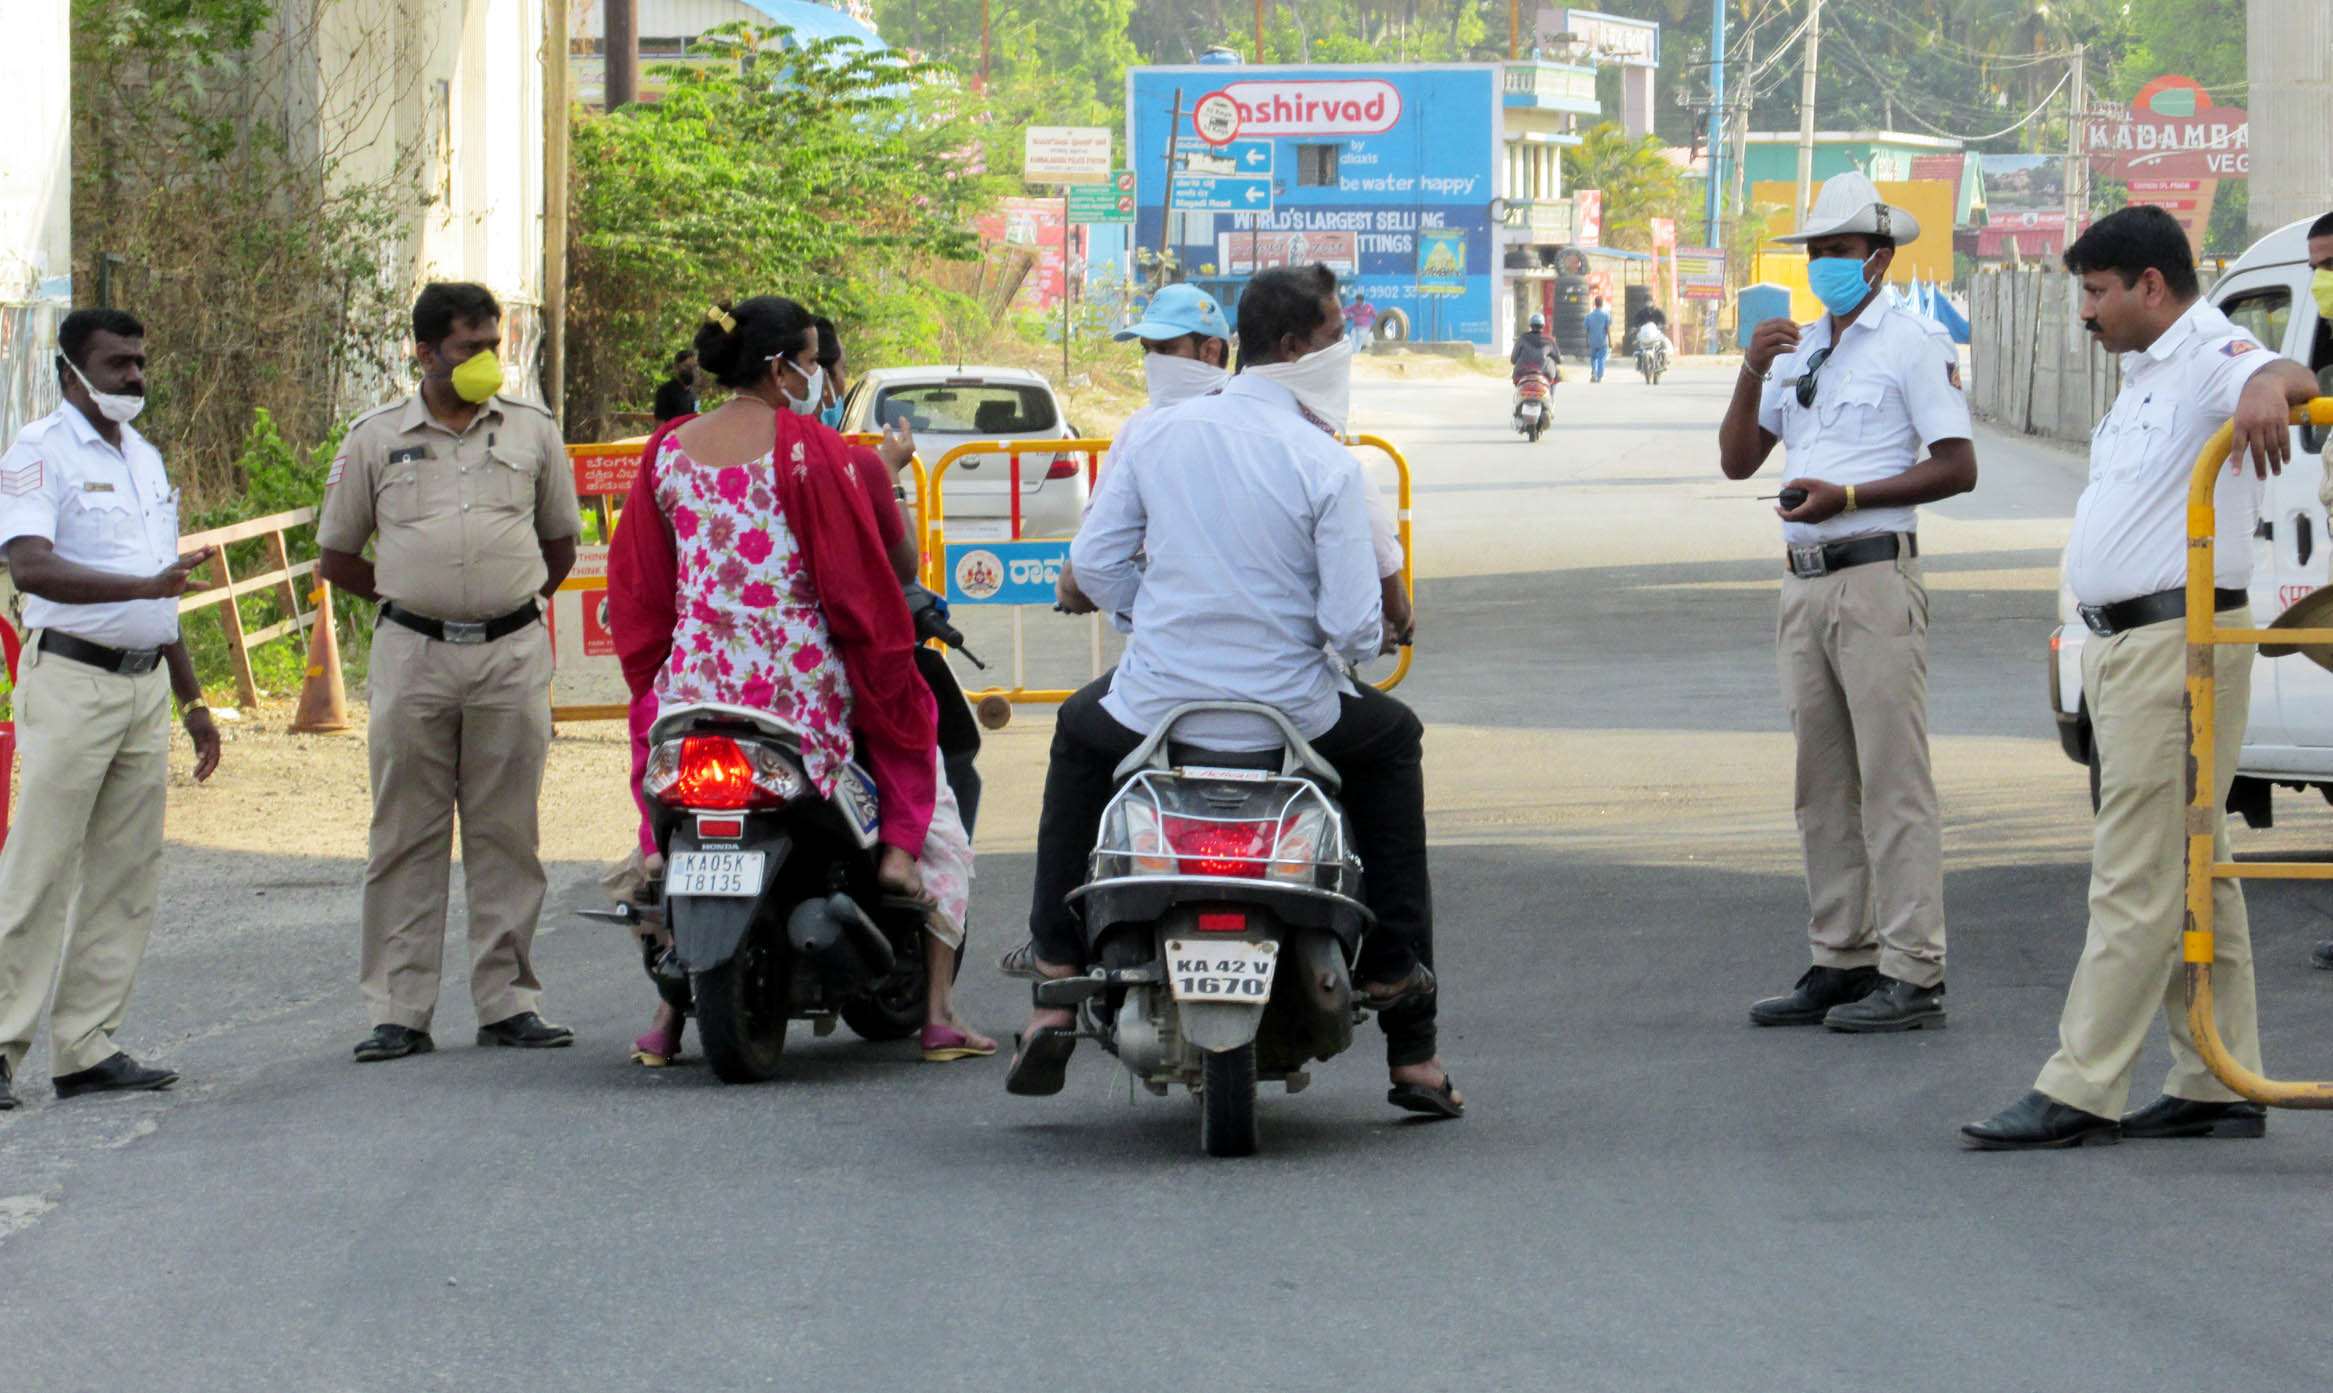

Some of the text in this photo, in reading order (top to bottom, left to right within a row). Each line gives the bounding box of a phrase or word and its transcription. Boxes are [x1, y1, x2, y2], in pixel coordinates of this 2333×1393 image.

[1351, 140, 1365, 152] by
[1340, 173, 1475, 195] be water happy
[1305, 211, 1373, 230] LARGEST
[702, 843, 740, 851] HONDA
[686, 855, 745, 872] KA05K
[685, 874, 742, 892] T8135
[1177, 960, 1269, 974] KA 42 V
[1178, 978, 1265, 995] 1670
